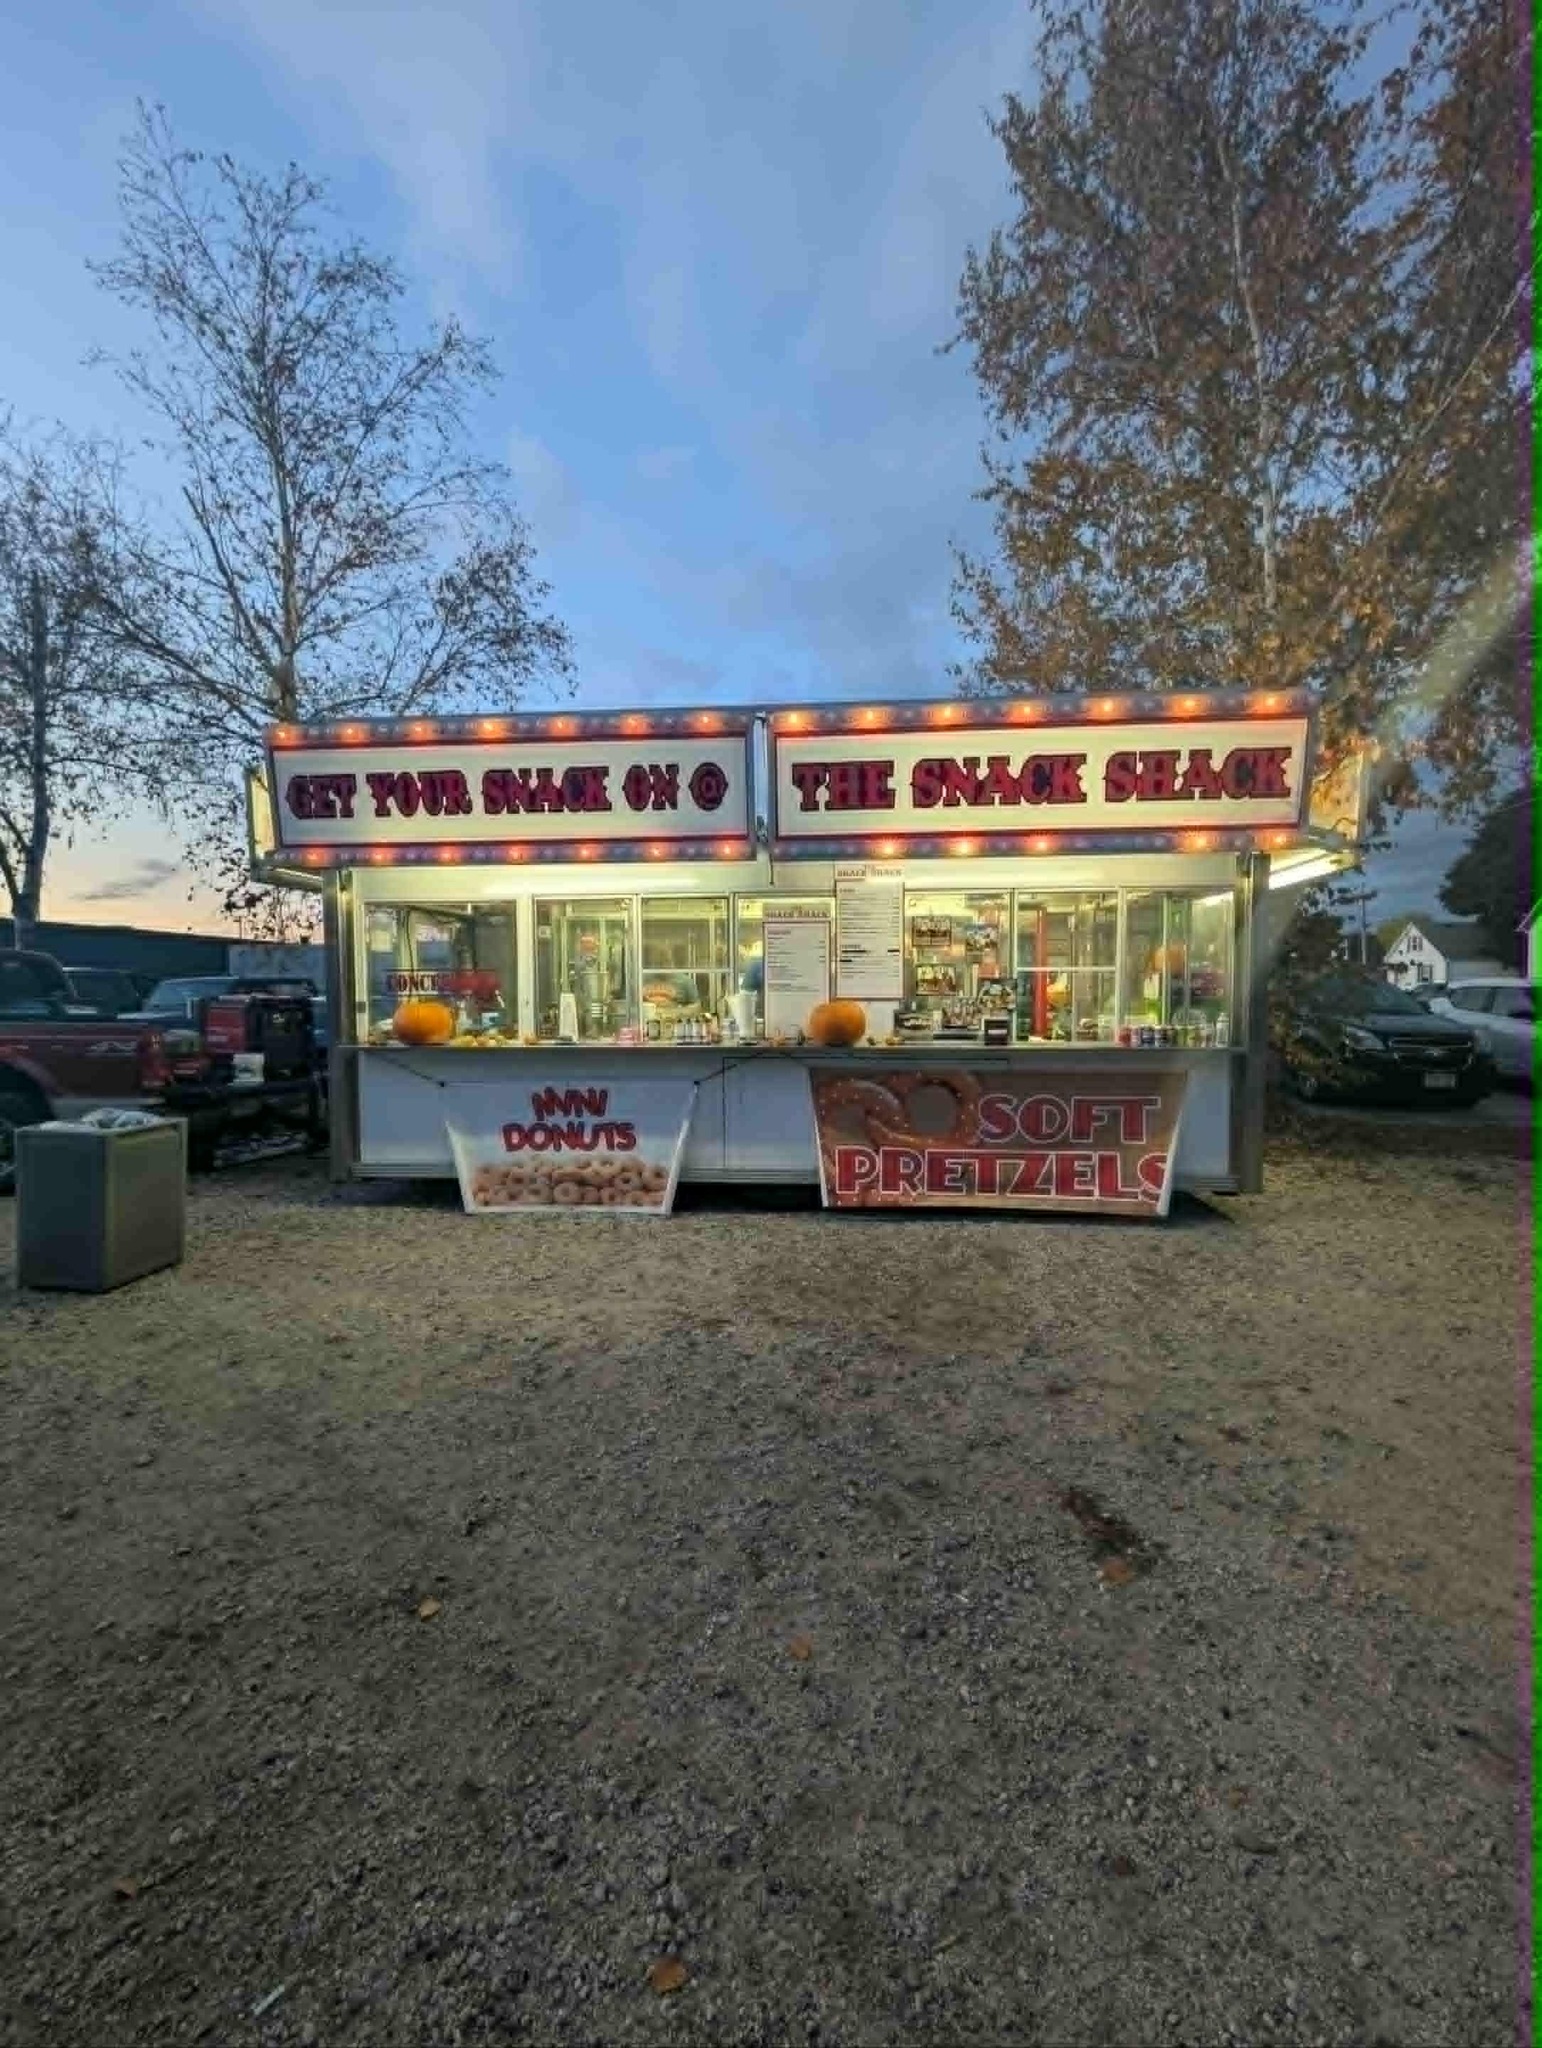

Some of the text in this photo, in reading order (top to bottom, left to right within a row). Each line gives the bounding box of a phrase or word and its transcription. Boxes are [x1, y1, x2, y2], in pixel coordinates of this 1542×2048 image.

[286, 761, 728, 820] GET YOUR SNACK ON @
[792, 746, 1292, 811] THE SNACK SHACK
[502, 1121, 636, 1152] DONUTS
[978, 1094, 1161, 1144] SOFT
[834, 1144, 1170, 1203] PRETZELS
